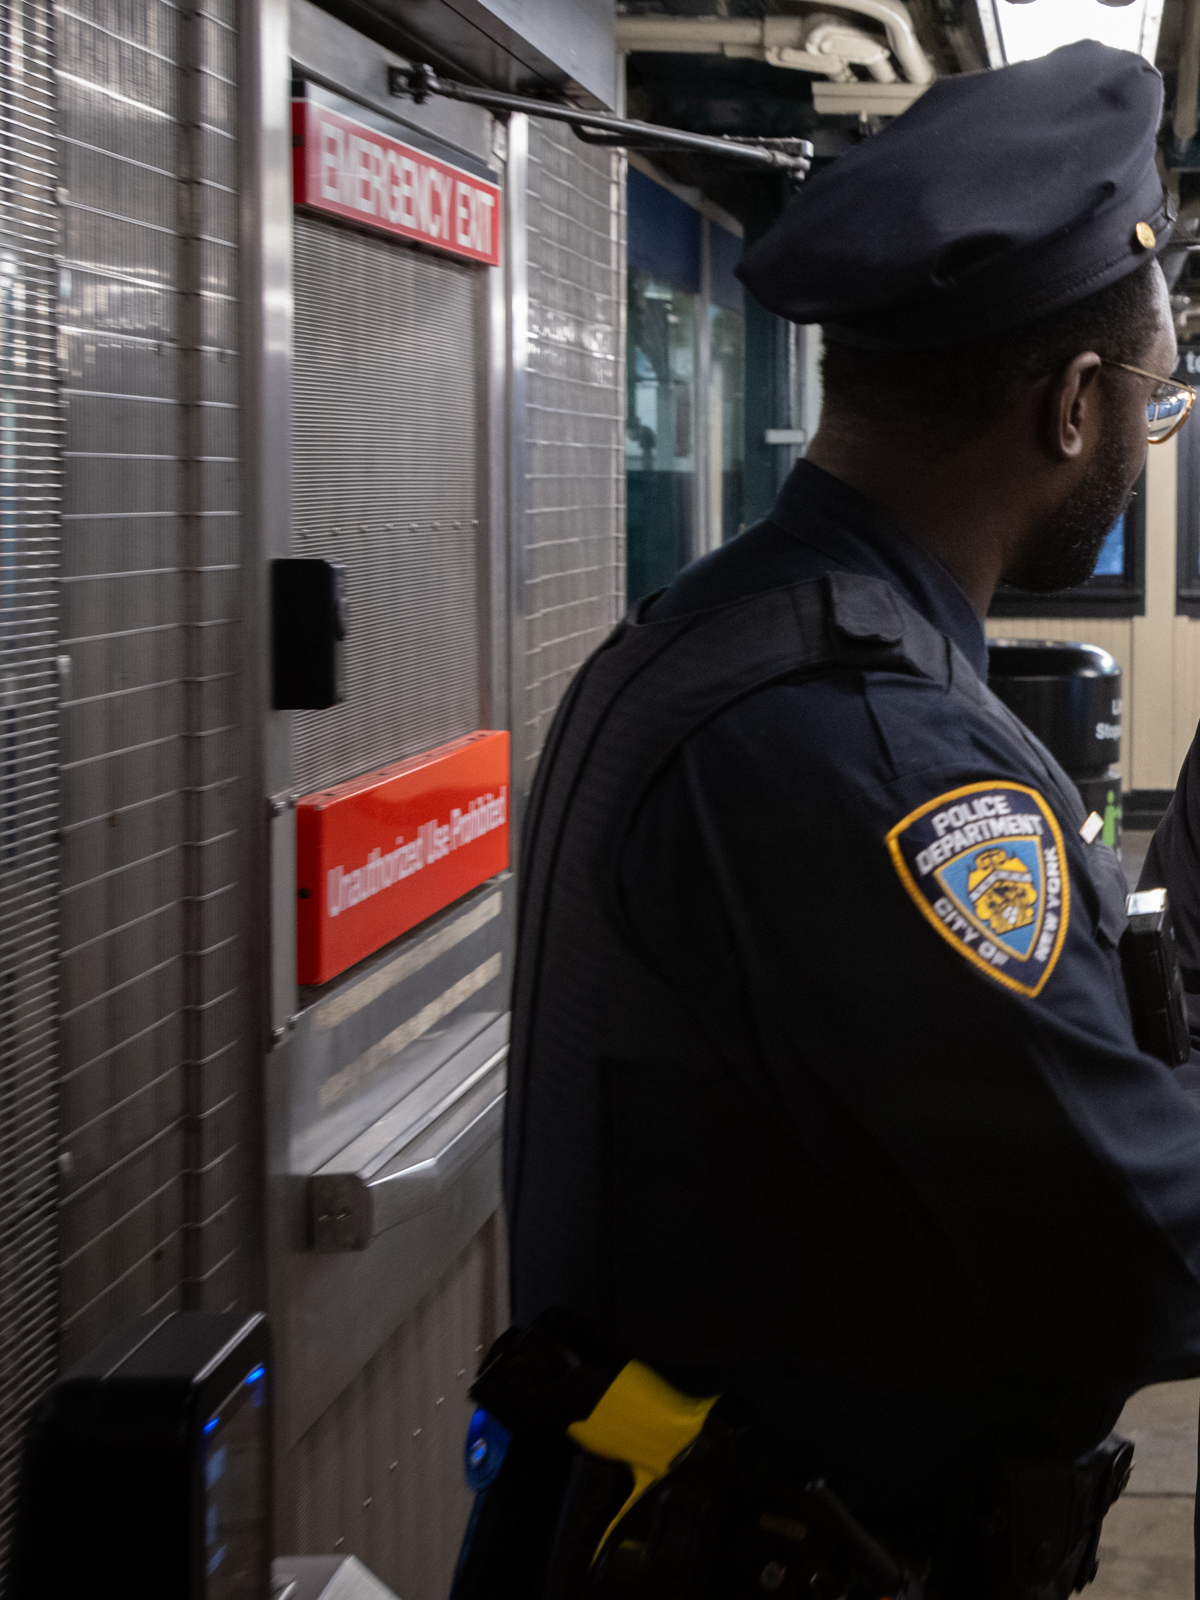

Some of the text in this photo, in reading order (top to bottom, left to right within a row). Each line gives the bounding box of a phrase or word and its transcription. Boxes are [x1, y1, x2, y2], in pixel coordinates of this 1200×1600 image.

[320, 120, 495, 256] EMERGENCY EXIT
[326, 785, 507, 918] Unauthorized Use Prohibited
[915, 814, 1044, 876] DEPARTMENT
[931, 795, 1012, 837] POLICE
[933, 846, 1061, 966] CITY OF NEW YORK
